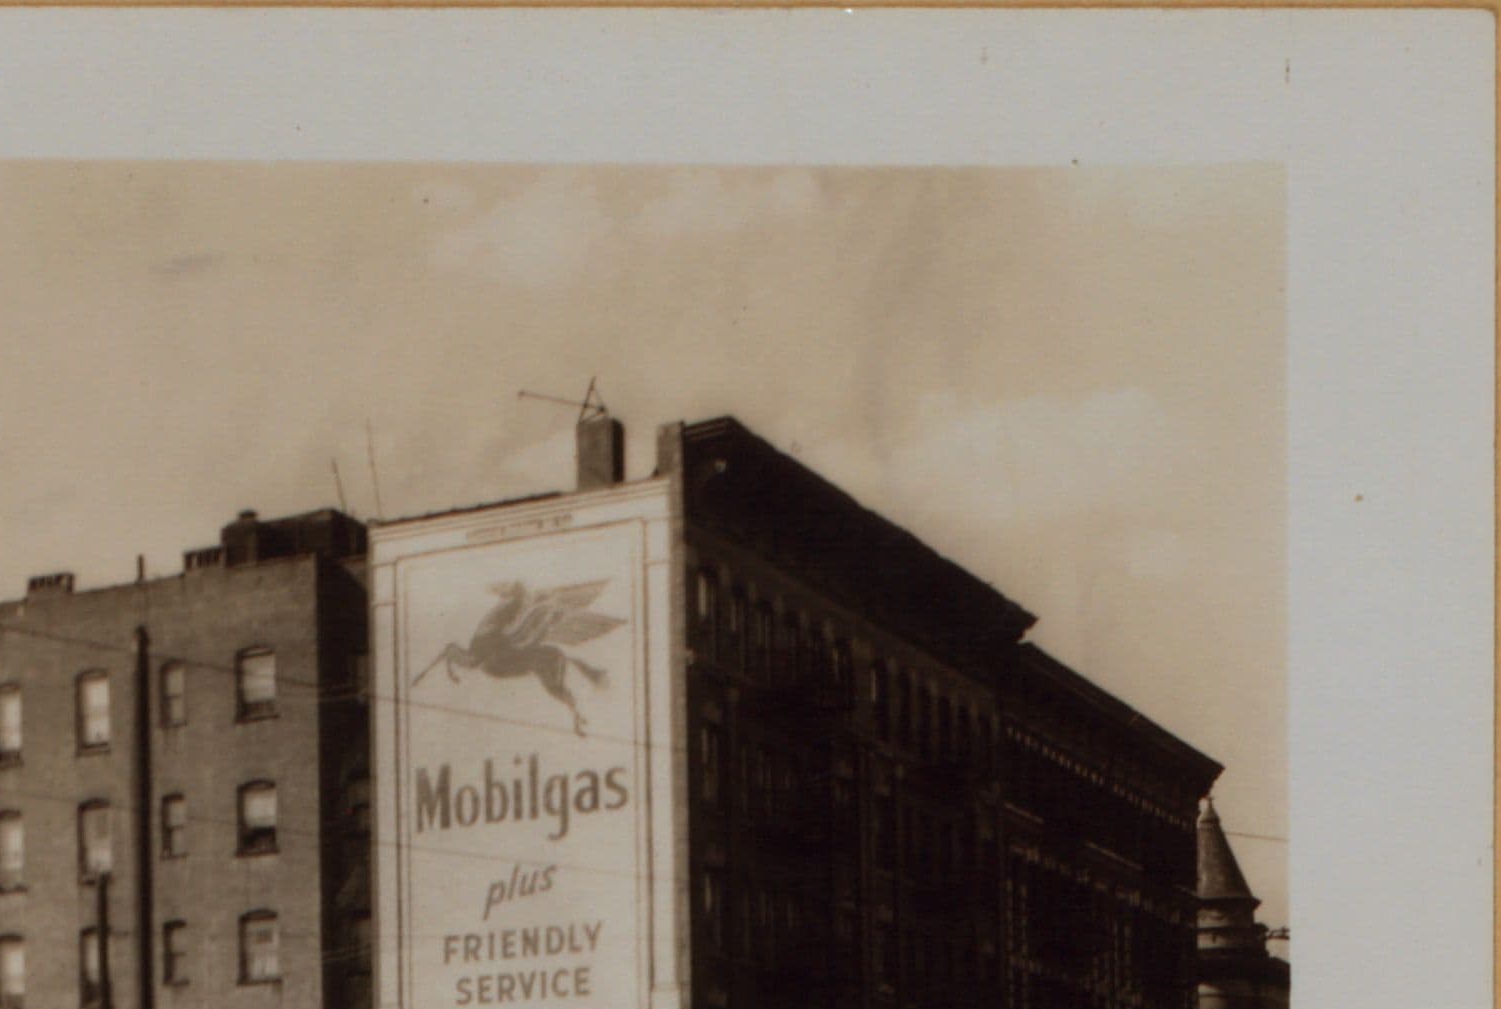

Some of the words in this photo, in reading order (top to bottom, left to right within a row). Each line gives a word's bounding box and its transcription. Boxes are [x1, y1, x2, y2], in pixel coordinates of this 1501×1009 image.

[415, 754, 629, 841] Mobilgas
[483, 864, 557, 921] plus
[443, 921, 603, 964] FRIENDLY
[455, 967, 592, 1006] SERVICE
